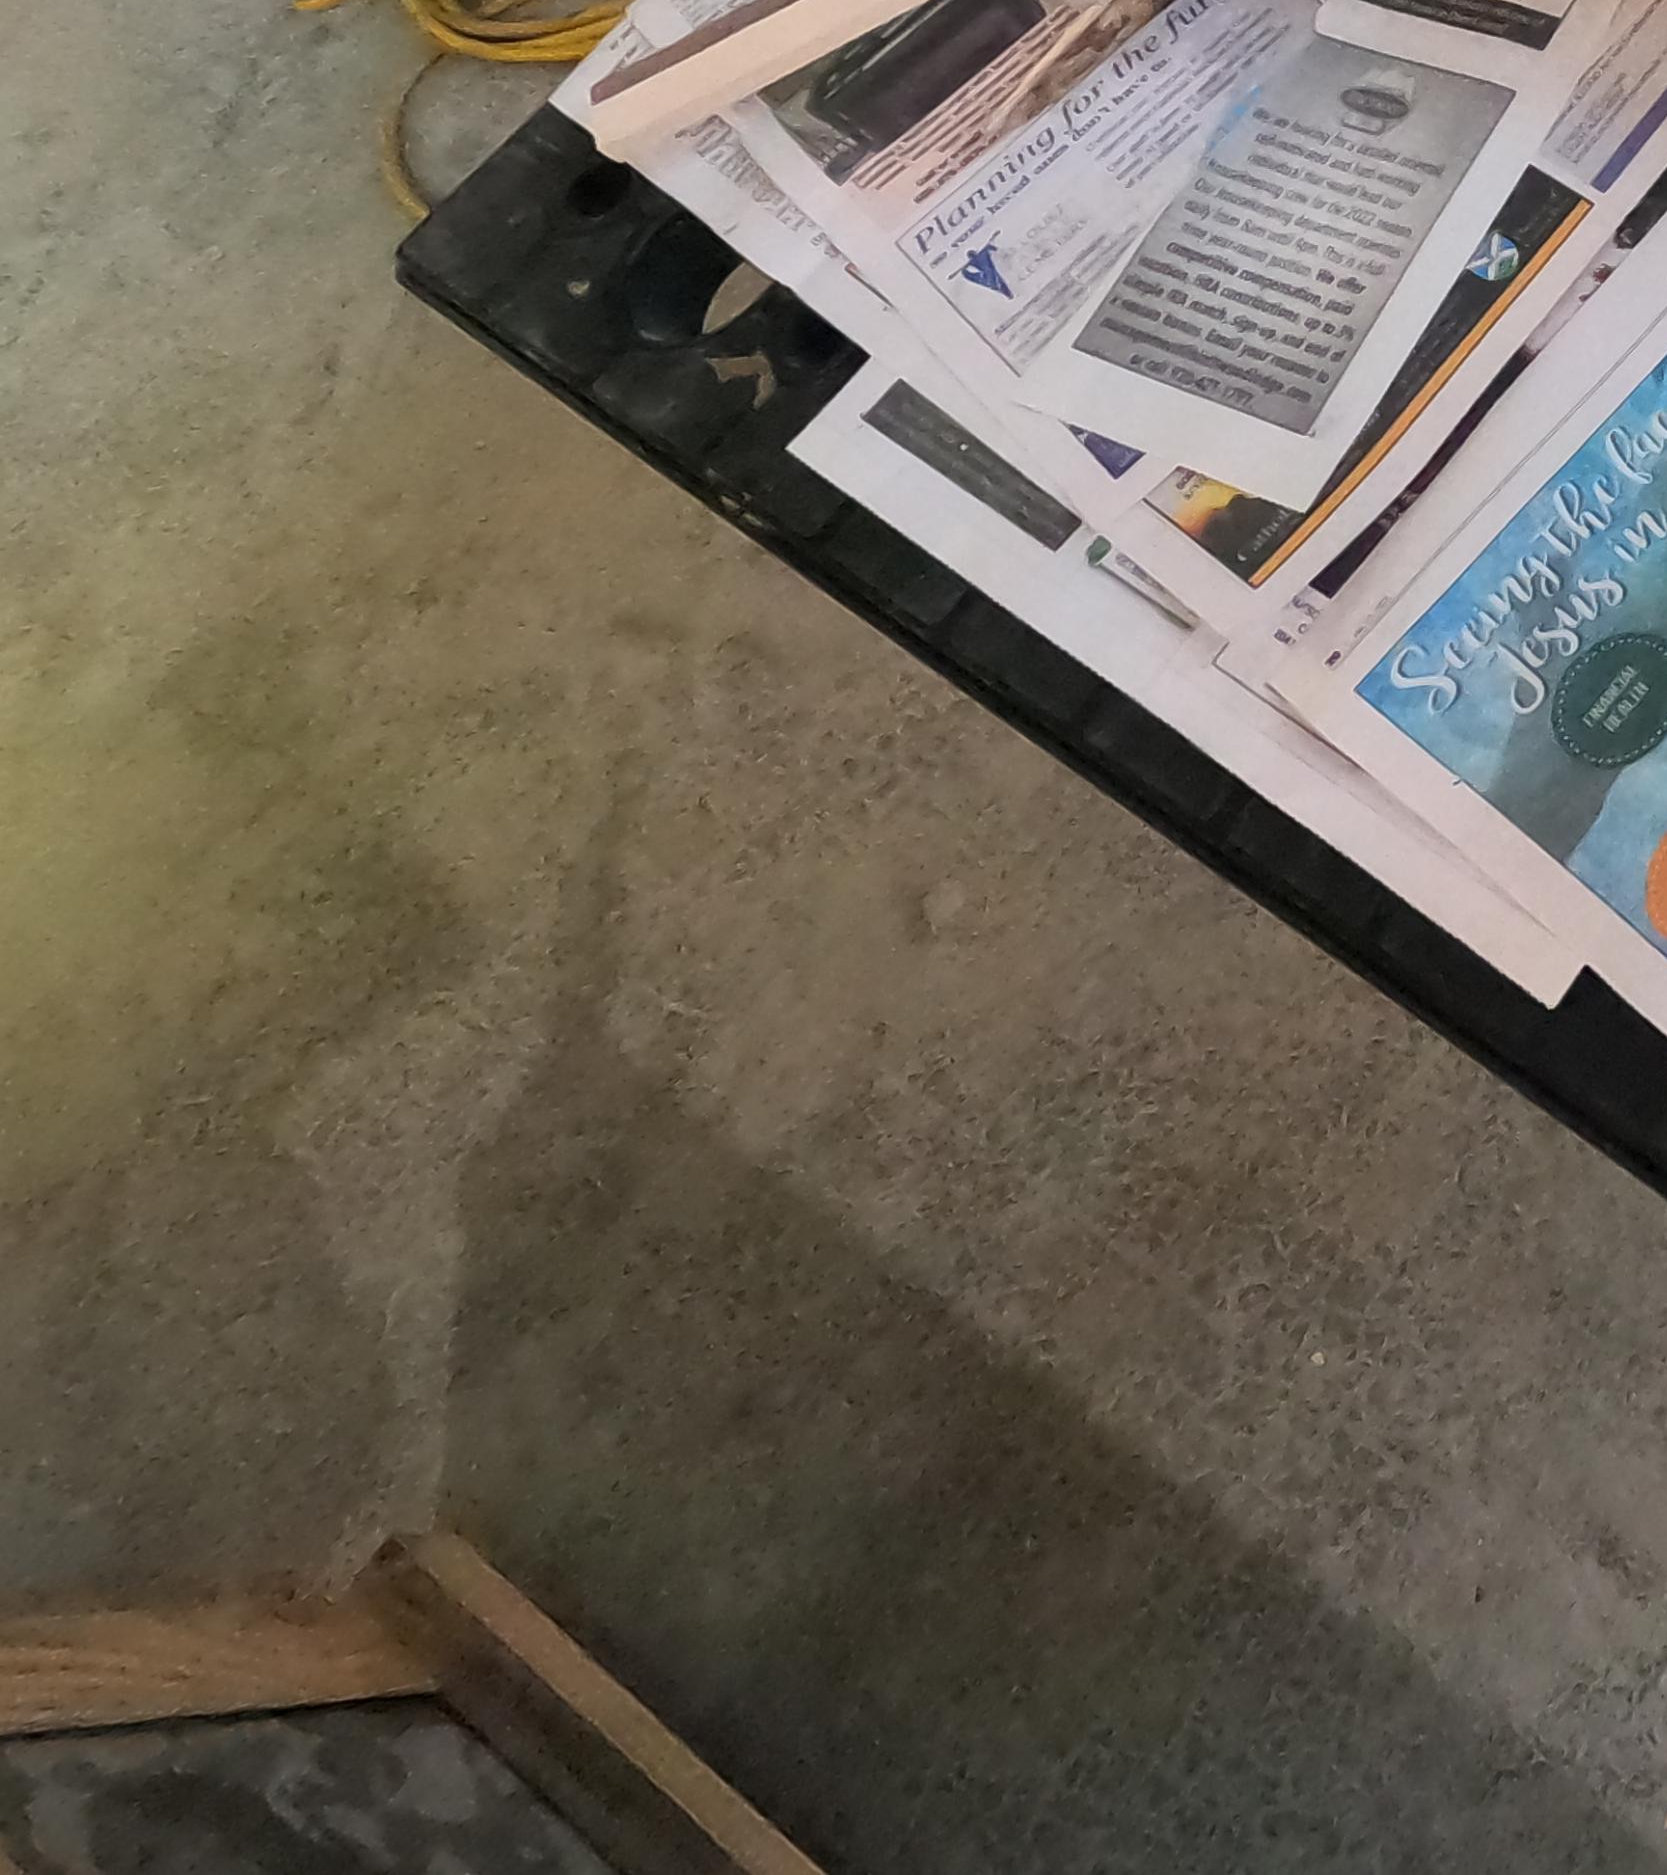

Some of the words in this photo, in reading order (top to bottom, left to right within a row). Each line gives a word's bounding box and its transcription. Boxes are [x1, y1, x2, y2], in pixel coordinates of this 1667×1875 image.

[912, 124, 1060, 255] Planning
[1052, 75, 1115, 137] for
[1109, 30, 1163, 81] the
[1383, 527, 1571, 722] Seeing
[1526, 453, 1635, 563] the
[1472, 545, 1641, 719] Jesus
